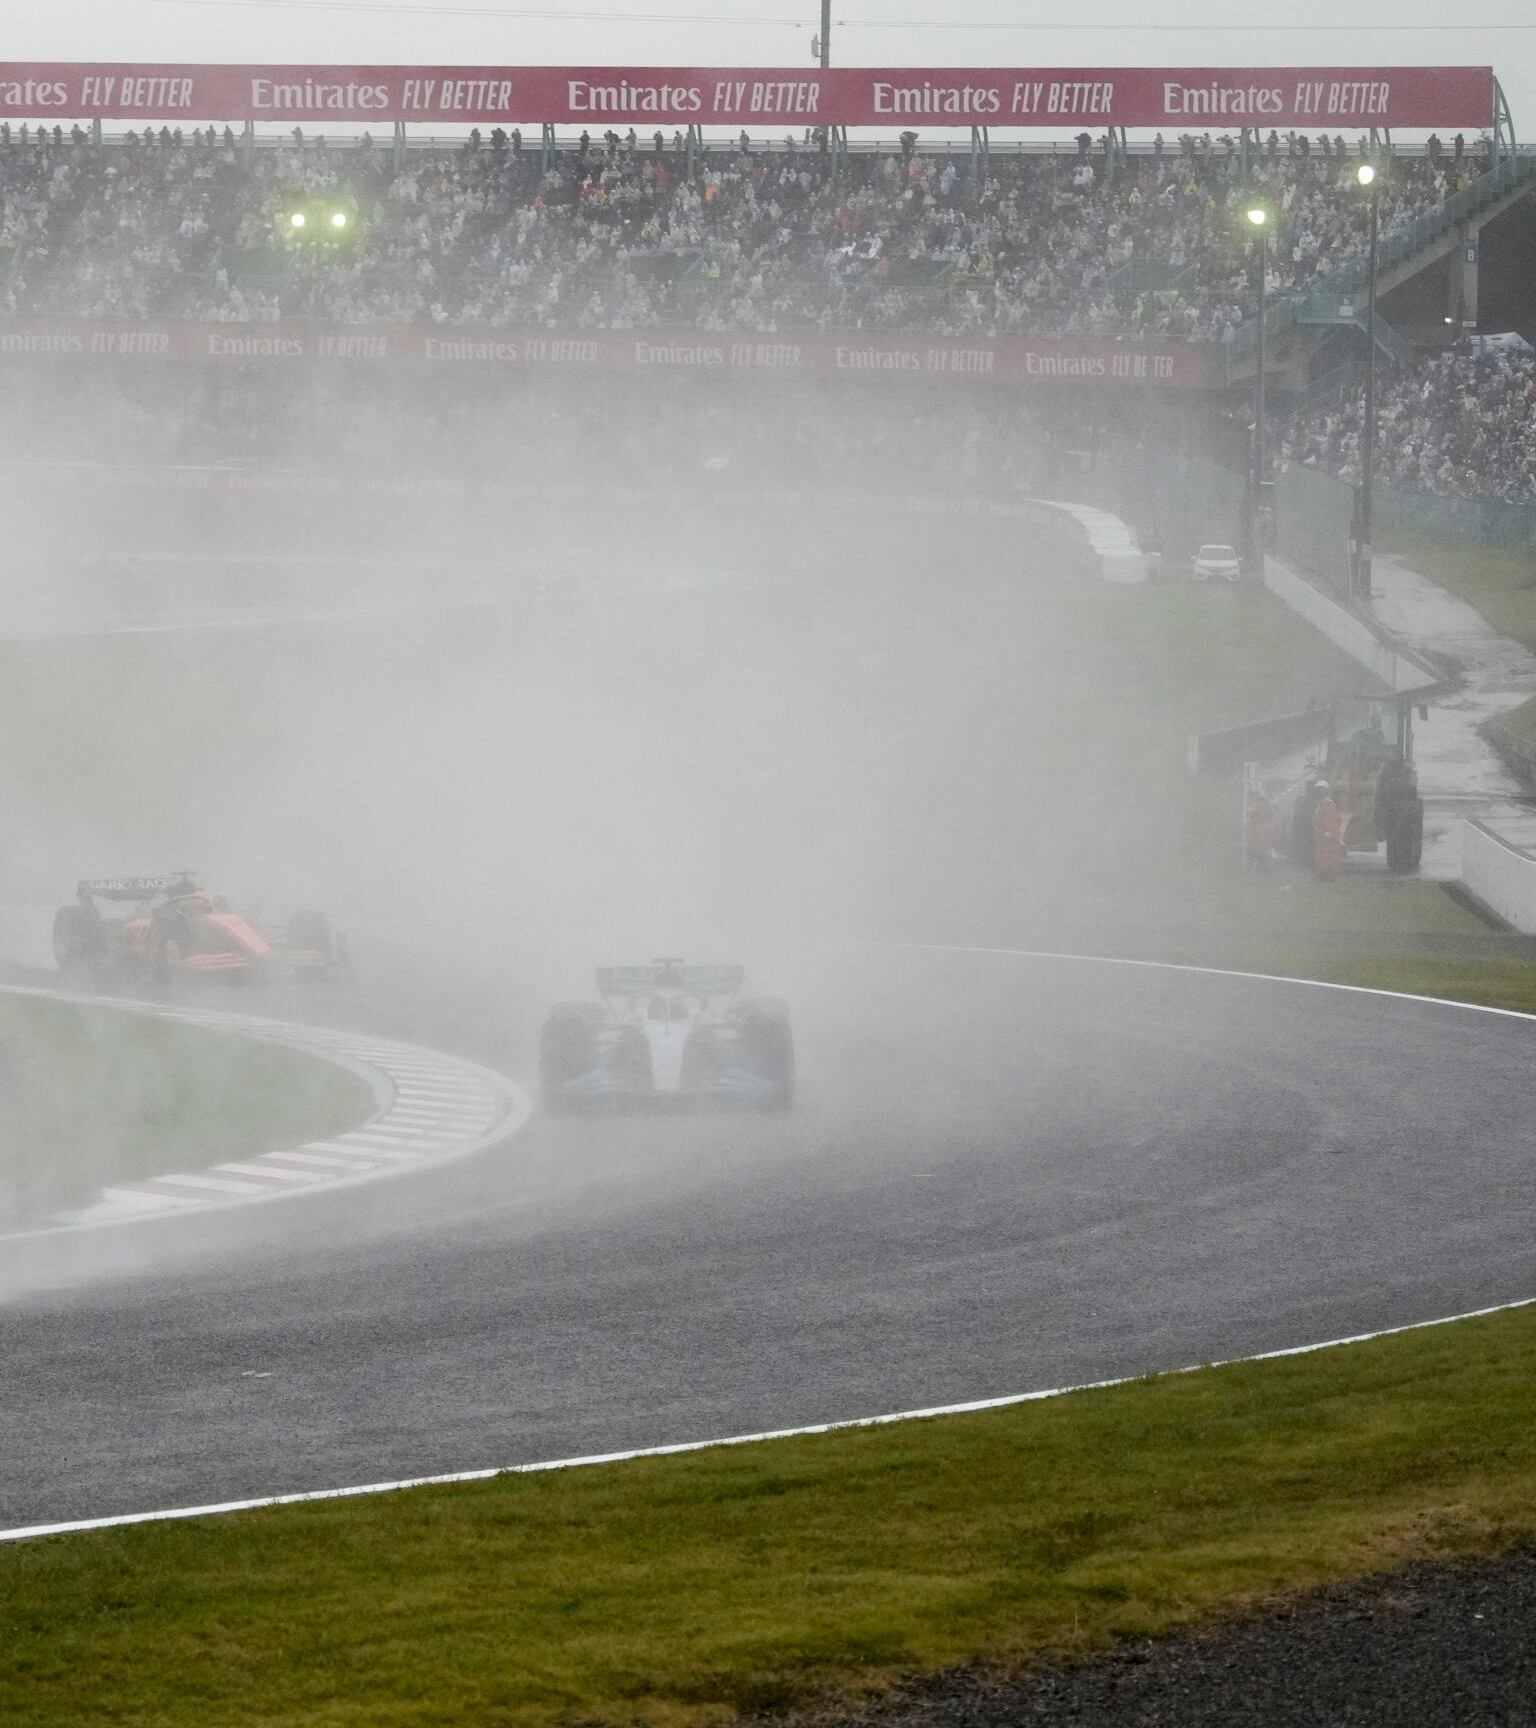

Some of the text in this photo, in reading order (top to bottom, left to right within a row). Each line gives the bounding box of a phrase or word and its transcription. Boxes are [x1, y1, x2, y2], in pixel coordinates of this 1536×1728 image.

[80, 77, 116, 106] FLY
[119, 78, 193, 107] BETTER
[251, 78, 512, 110] Emirates FLY BETTER
[568, 80, 820, 112] Emirates FLY BETTER
[873, 82, 1113, 113] Emirates FLY BETTER
[1164, 82, 1389, 114] Emirates FLY BETTER
[90, 333, 118, 354] FLY
[119, 333, 169, 355] BETTER
[207, 334, 303, 356] Emirates
[338, 336, 387, 358] BETTER
[425, 338, 599, 362] Emirates FLY BETTER
[635, 342, 801, 366] Emirates FLY BETTER
[836, 347, 995, 372] Emirates FLY BETTER
[1025, 353, 1106, 375] Emirates
[1112, 354, 1134, 377] FLY
